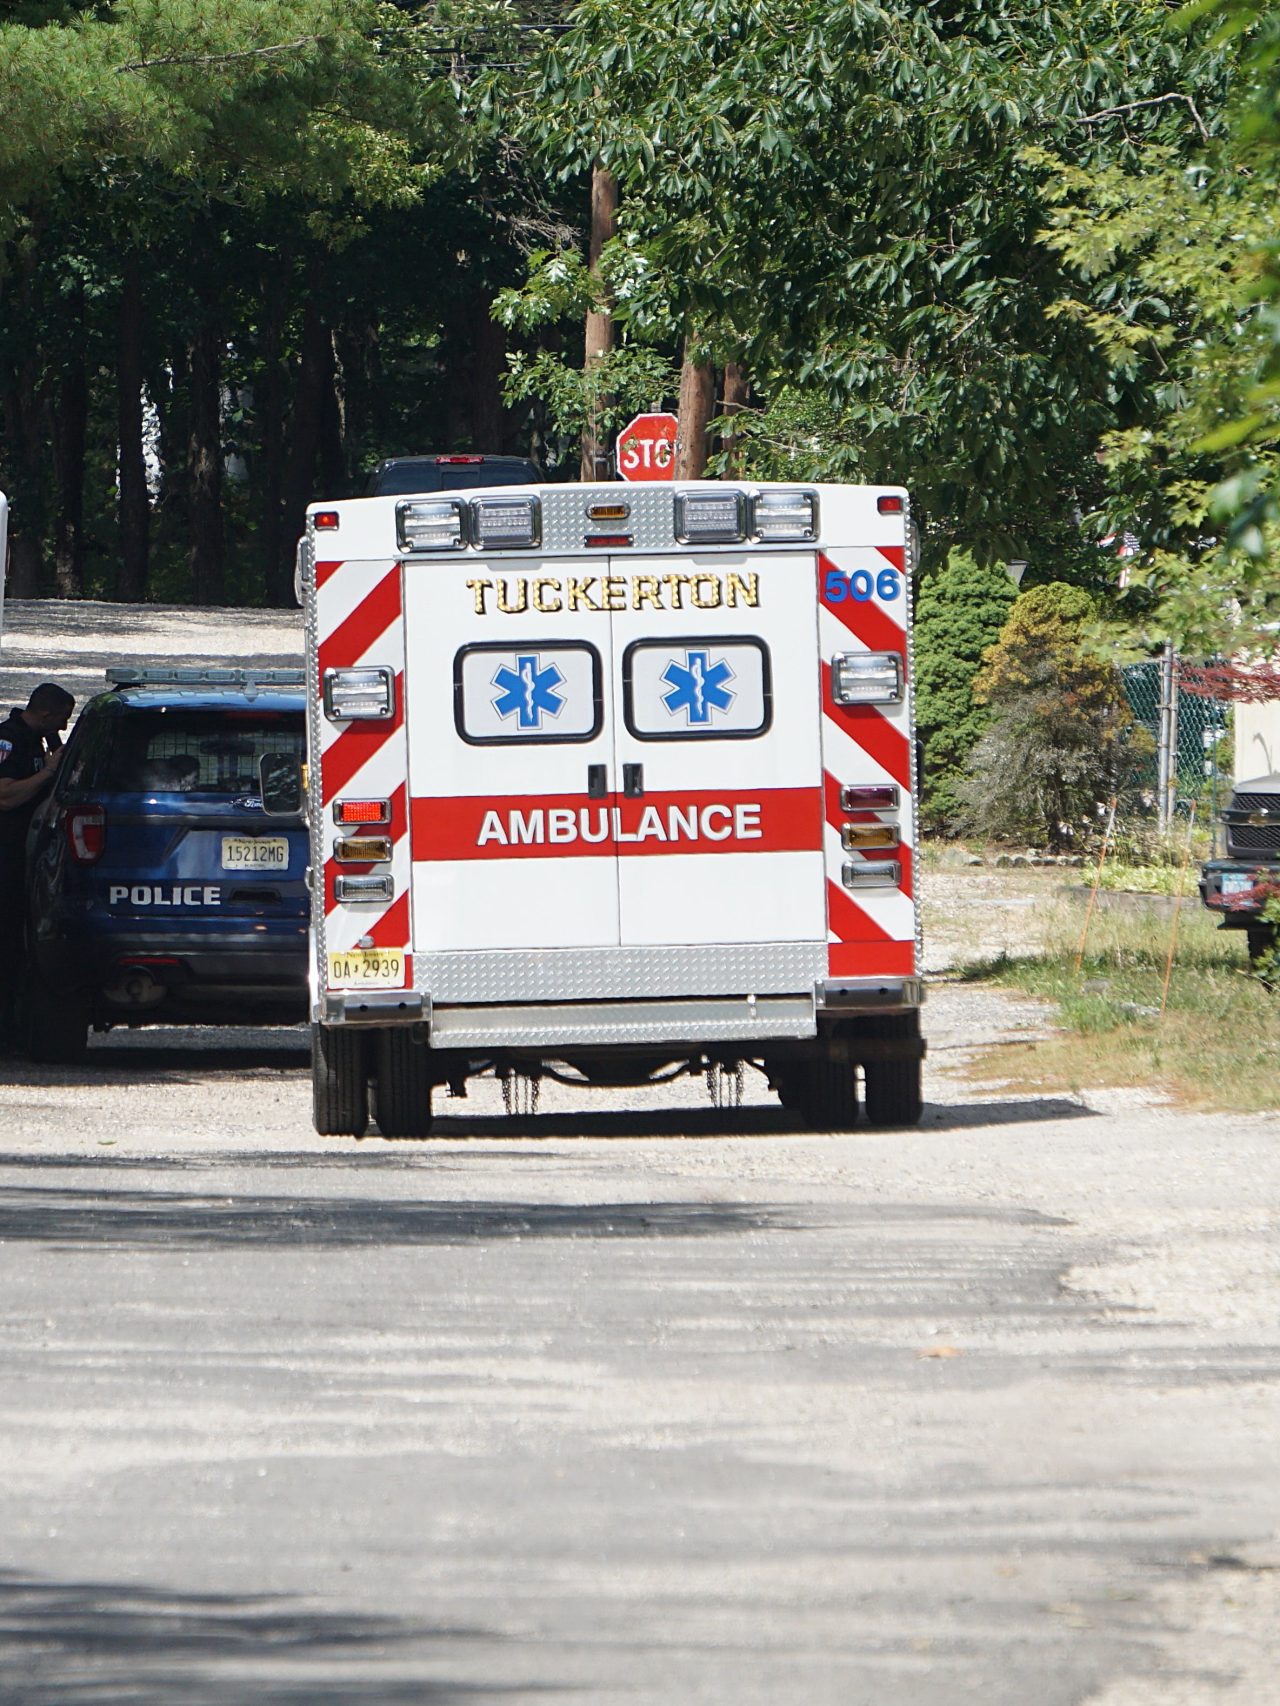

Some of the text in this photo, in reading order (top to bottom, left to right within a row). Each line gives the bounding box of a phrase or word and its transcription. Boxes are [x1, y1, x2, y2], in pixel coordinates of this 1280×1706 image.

[624, 439, 677, 468] STO
[466, 572, 760, 615] TUCKERTON
[825, 569, 901, 602] 506
[477, 803, 763, 846] AMBULANCE
[227, 846, 284, 862] 15212MG
[109, 886, 221, 905] POLICE
